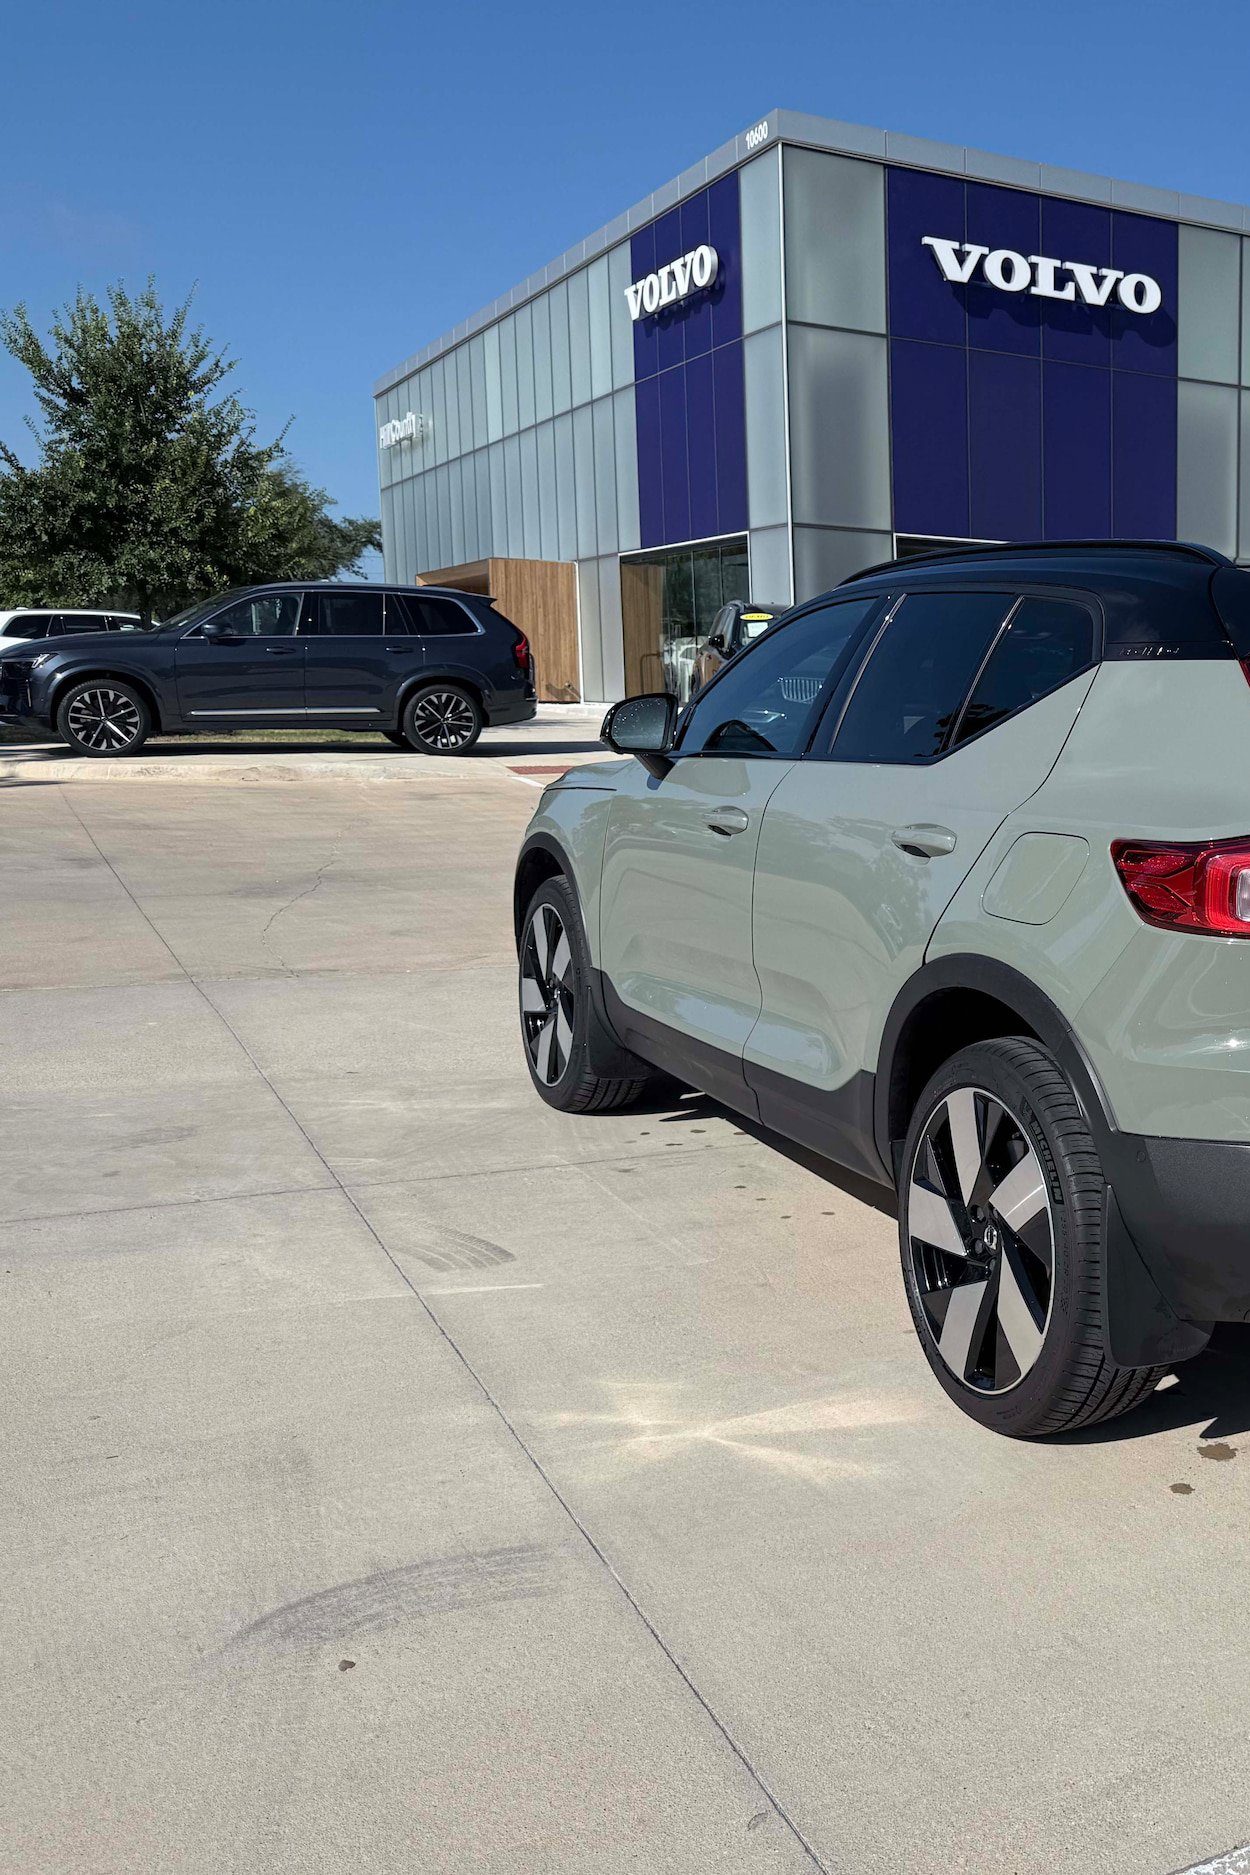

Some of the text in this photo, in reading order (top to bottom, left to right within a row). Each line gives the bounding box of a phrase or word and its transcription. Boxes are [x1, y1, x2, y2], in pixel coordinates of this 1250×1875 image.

[746, 121, 768, 150] 10600
[624, 244, 717, 320] VOLVO
[921, 236, 1162, 314] VOLVO
[1029, 1120, 1063, 1202] MICHELIN
